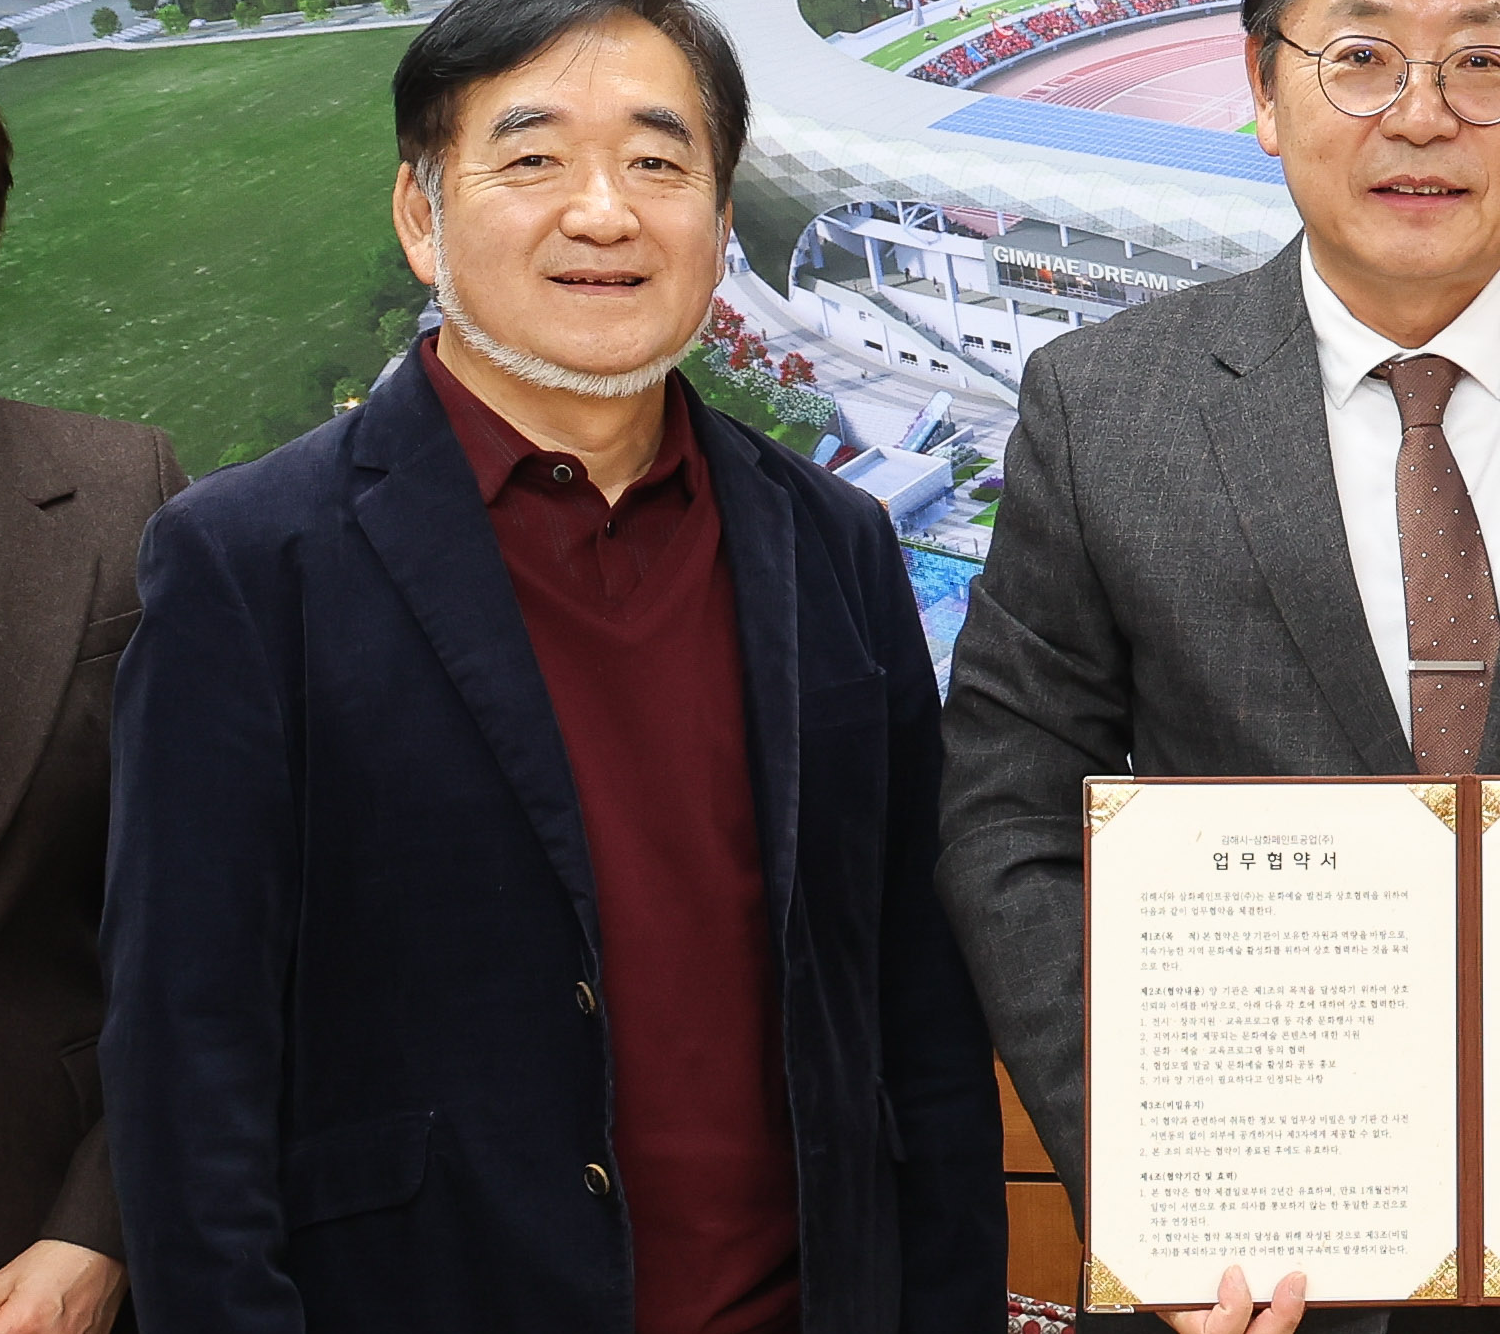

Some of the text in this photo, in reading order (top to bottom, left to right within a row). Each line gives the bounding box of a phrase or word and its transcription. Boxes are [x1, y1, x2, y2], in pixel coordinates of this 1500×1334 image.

[992, 245, 1080, 277] GIMHAE
[1088, 262, 1168, 292] DREAM
[1221, 835, 1334, 845] 김해시-삼화페인트공업(주)
[1140, 891, 1175, 901] 김해시와
[1140, 906, 1166, 917] 다음과
